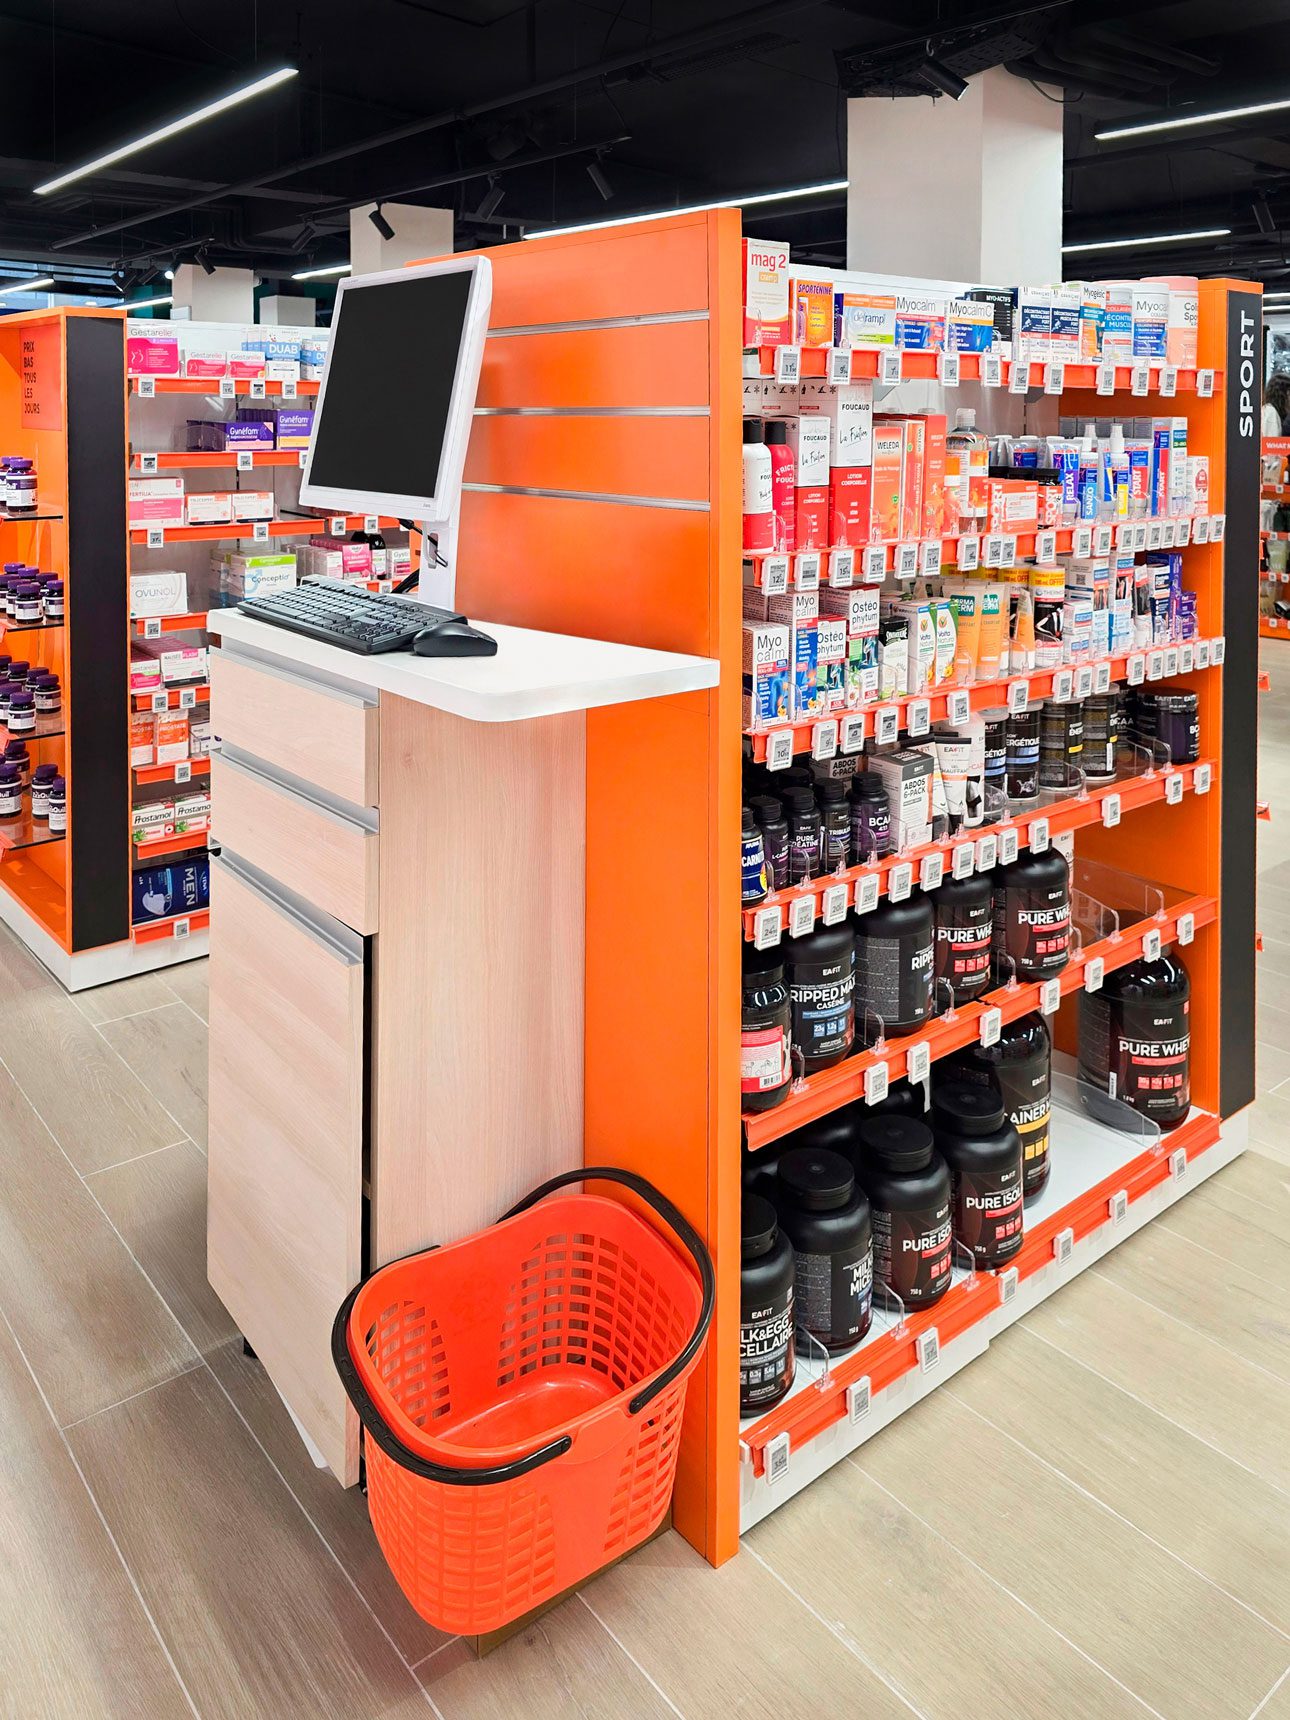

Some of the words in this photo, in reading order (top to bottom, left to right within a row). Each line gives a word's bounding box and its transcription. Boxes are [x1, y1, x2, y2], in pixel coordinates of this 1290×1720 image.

[751, 254, 776, 272] mag
[778, 254, 787, 269] 2
[896, 297, 936, 313] Myocalm
[23, 342, 35, 353] PRIX
[269, 344, 298, 354] DUAB
[23, 357, 34, 368] BAS
[23, 372, 36, 383] TOUS
[1239, 310, 1255, 437] SPORT
[24, 388, 33, 399] LES
[24, 403, 40, 415] JOURS
[842, 403, 870, 411] FOUCAUD
[877, 441, 900, 450] WELEDA
[1065, 472, 1074, 501] RELAX
[1132, 470, 1142, 495] START
[135, 588, 175, 598] OVUNOL
[796, 596, 815, 609] Myo
[852, 601, 878, 614] Ostéo
[757, 635, 783, 651] Myo
[756, 648, 786, 663] calm
[833, 760, 857, 770] ABDOS
[832, 768, 857, 778] 6-PACK
[904, 778, 926, 791] ABDOS
[904, 788, 927, 800] 6-PACK
[135, 811, 173, 825] Prostamol
[796, 834, 814, 843] PURE
[184, 867, 198, 906] MEN
[1017, 911, 1055, 926] PURE
[937, 929, 975, 943] PURE
[790, 985, 840, 1004] RIPPED
[1119, 1041, 1160, 1057] PURE
[966, 1195, 1002, 1210] PURE
[902, 1234, 937, 1252] PURE
